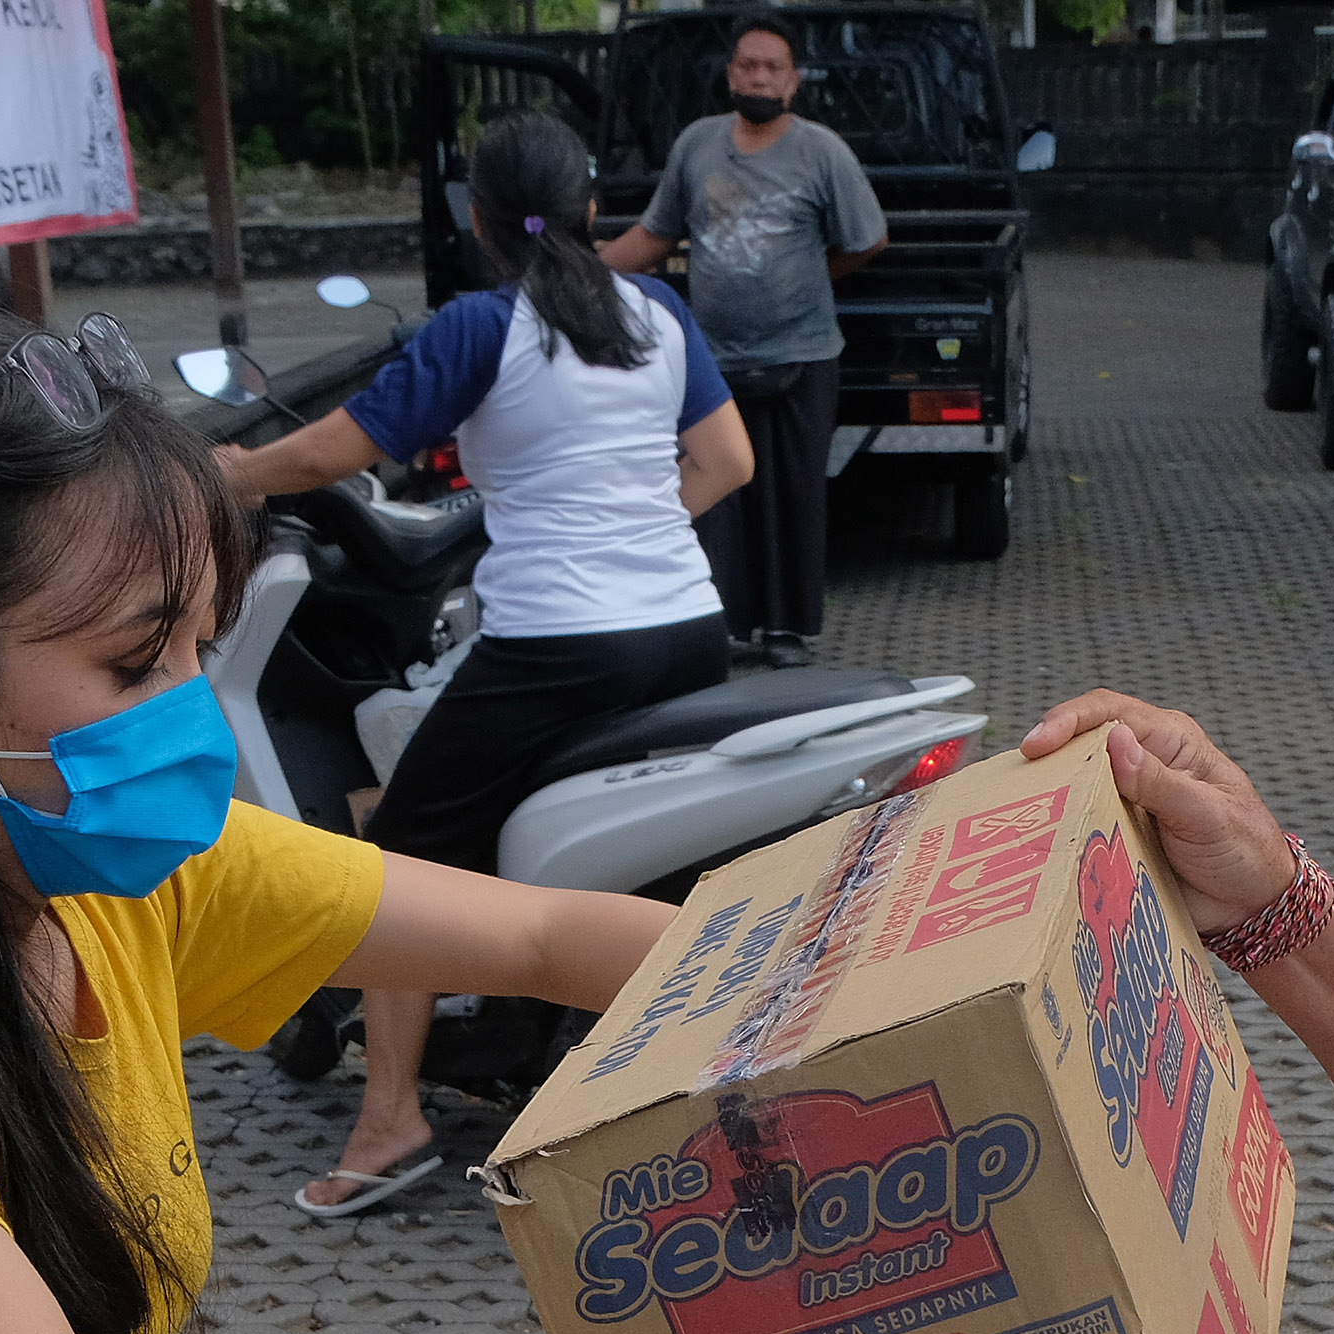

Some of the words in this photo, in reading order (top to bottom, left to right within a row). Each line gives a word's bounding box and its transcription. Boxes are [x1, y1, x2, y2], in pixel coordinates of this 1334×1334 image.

[903, 823, 946, 868] broken
[882, 896, 925, 932] accept
[657, 962, 709, 991] 8
[1072, 918, 1104, 1016] Mie
[1087, 861, 1178, 1168] Sedaap
[1155, 997, 1185, 1109] Instant
[601, 1152, 711, 1223] Mie
[1235, 1091, 1271, 1236] GORENG
[797, 1231, 953, 1311] Instant
[873, 1282, 997, 1334] SEDAPNYA
